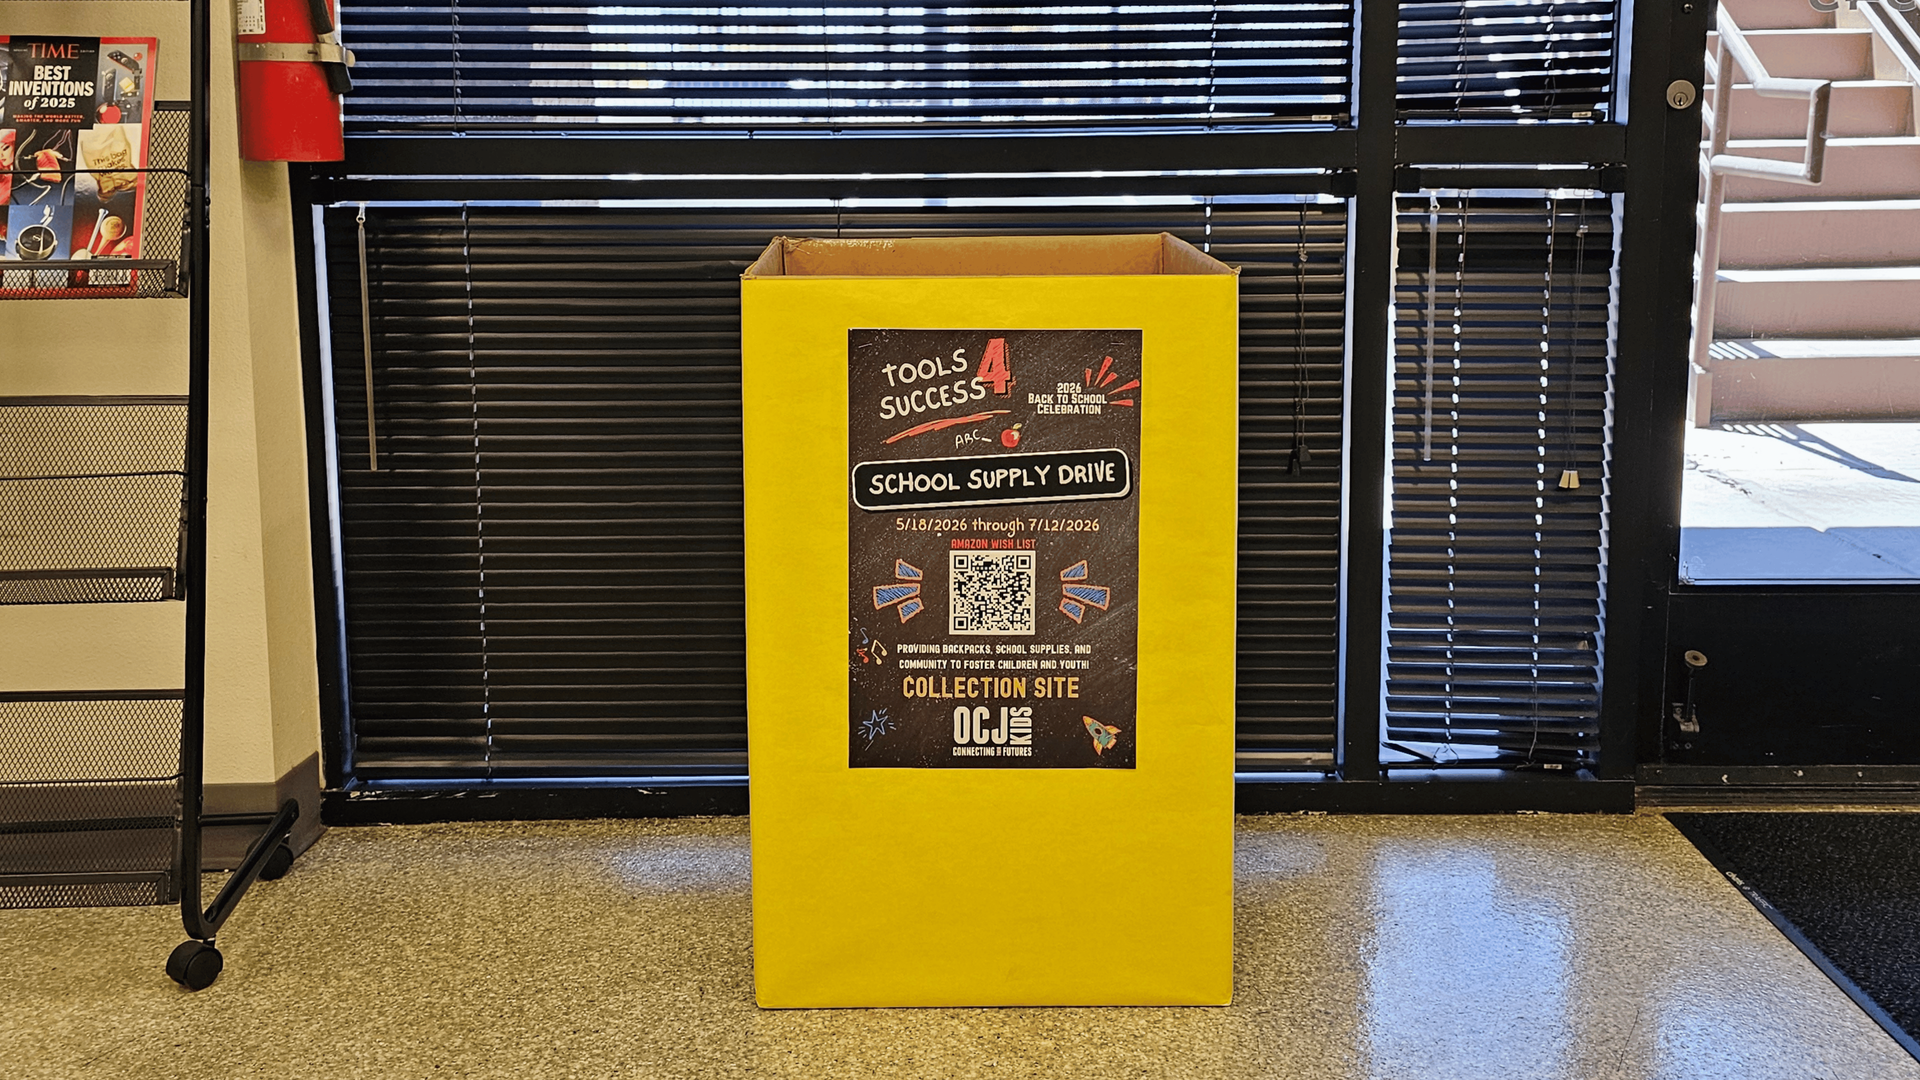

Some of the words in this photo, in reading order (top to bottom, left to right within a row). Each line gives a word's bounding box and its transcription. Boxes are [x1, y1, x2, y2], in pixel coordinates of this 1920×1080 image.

[27, 43, 80, 60] TIME
[33, 65, 72, 81] BEST
[8, 80, 94, 97] INVENTIONS
[23, 96, 40, 110] of
[40, 97, 76, 108] 2025
[93, 156, 110, 166] This
[110, 149, 127, 162] bag
[881, 348, 968, 387] TOOLS
[976, 337, 1014, 398] 4
[1056, 382, 1082, 394] 2026
[879, 376, 986, 420] SUCCESS
[1028, 393, 1054, 404] BACK
[1056, 393, 1069, 404] TO
[1071, 393, 1108, 404] SCHOOL
[1037, 403, 1102, 415] CELEBRATION
[868, 471, 961, 495] SCHOOL
[967, 464, 1051, 490] SUPPLY
[1058, 459, 1116, 485] DRIVE
[896, 517, 968, 533] 5/18/2026
[971, 517, 1024, 537] through
[1028, 518, 1100, 532] 7/12/2026
[951, 538, 988, 549] AMAZON
[991, 538, 1014, 549] WISH
[1016, 538, 1036, 549] LIST
[897, 644, 941, 654] PROVIDING
[942, 644, 993, 655] BACKPACKS,
[995, 644, 1028, 654] SCHOOL
[1029, 644, 1072, 655] SUPPLIES,
[1074, 644, 1092, 654] AND
[899, 659, 947, 670] COMMUNITY
[950, 659, 961, 669] TO
[964, 659, 995, 670] FOSTER
[997, 659, 1038, 670] CHILDREN
[1040, 659, 1057, 669] AND
[1059, 659, 1090, 669] YOUTH!
[902, 676, 1026, 698] COLLECTION
[1034, 676, 1080, 698] SITE
[953, 706, 1008, 745] OCJ
[1009, 706, 1033, 745] KIDS
[952, 746, 995, 757] CONNECTING
[1002, 746, 1033, 757] FUTURES
